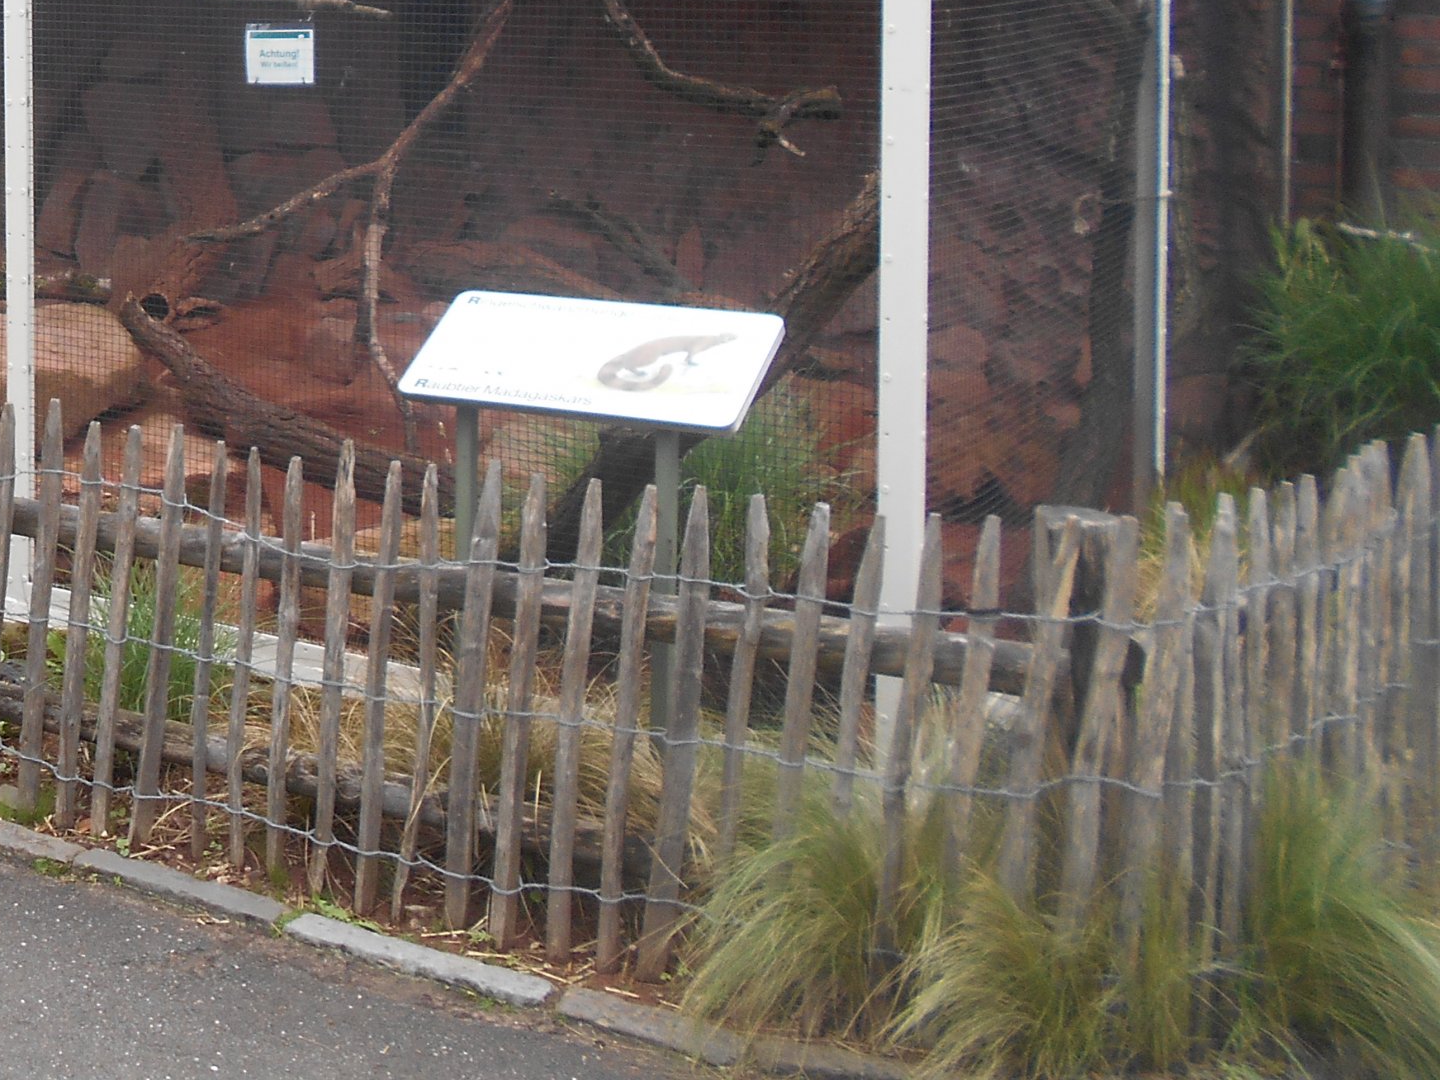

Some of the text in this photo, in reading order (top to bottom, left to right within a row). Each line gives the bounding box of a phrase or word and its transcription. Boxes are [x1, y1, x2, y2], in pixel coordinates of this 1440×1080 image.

[259, 49, 300, 60] Achtung!
[414, 378, 592, 406] Raubtier Madagaskars
